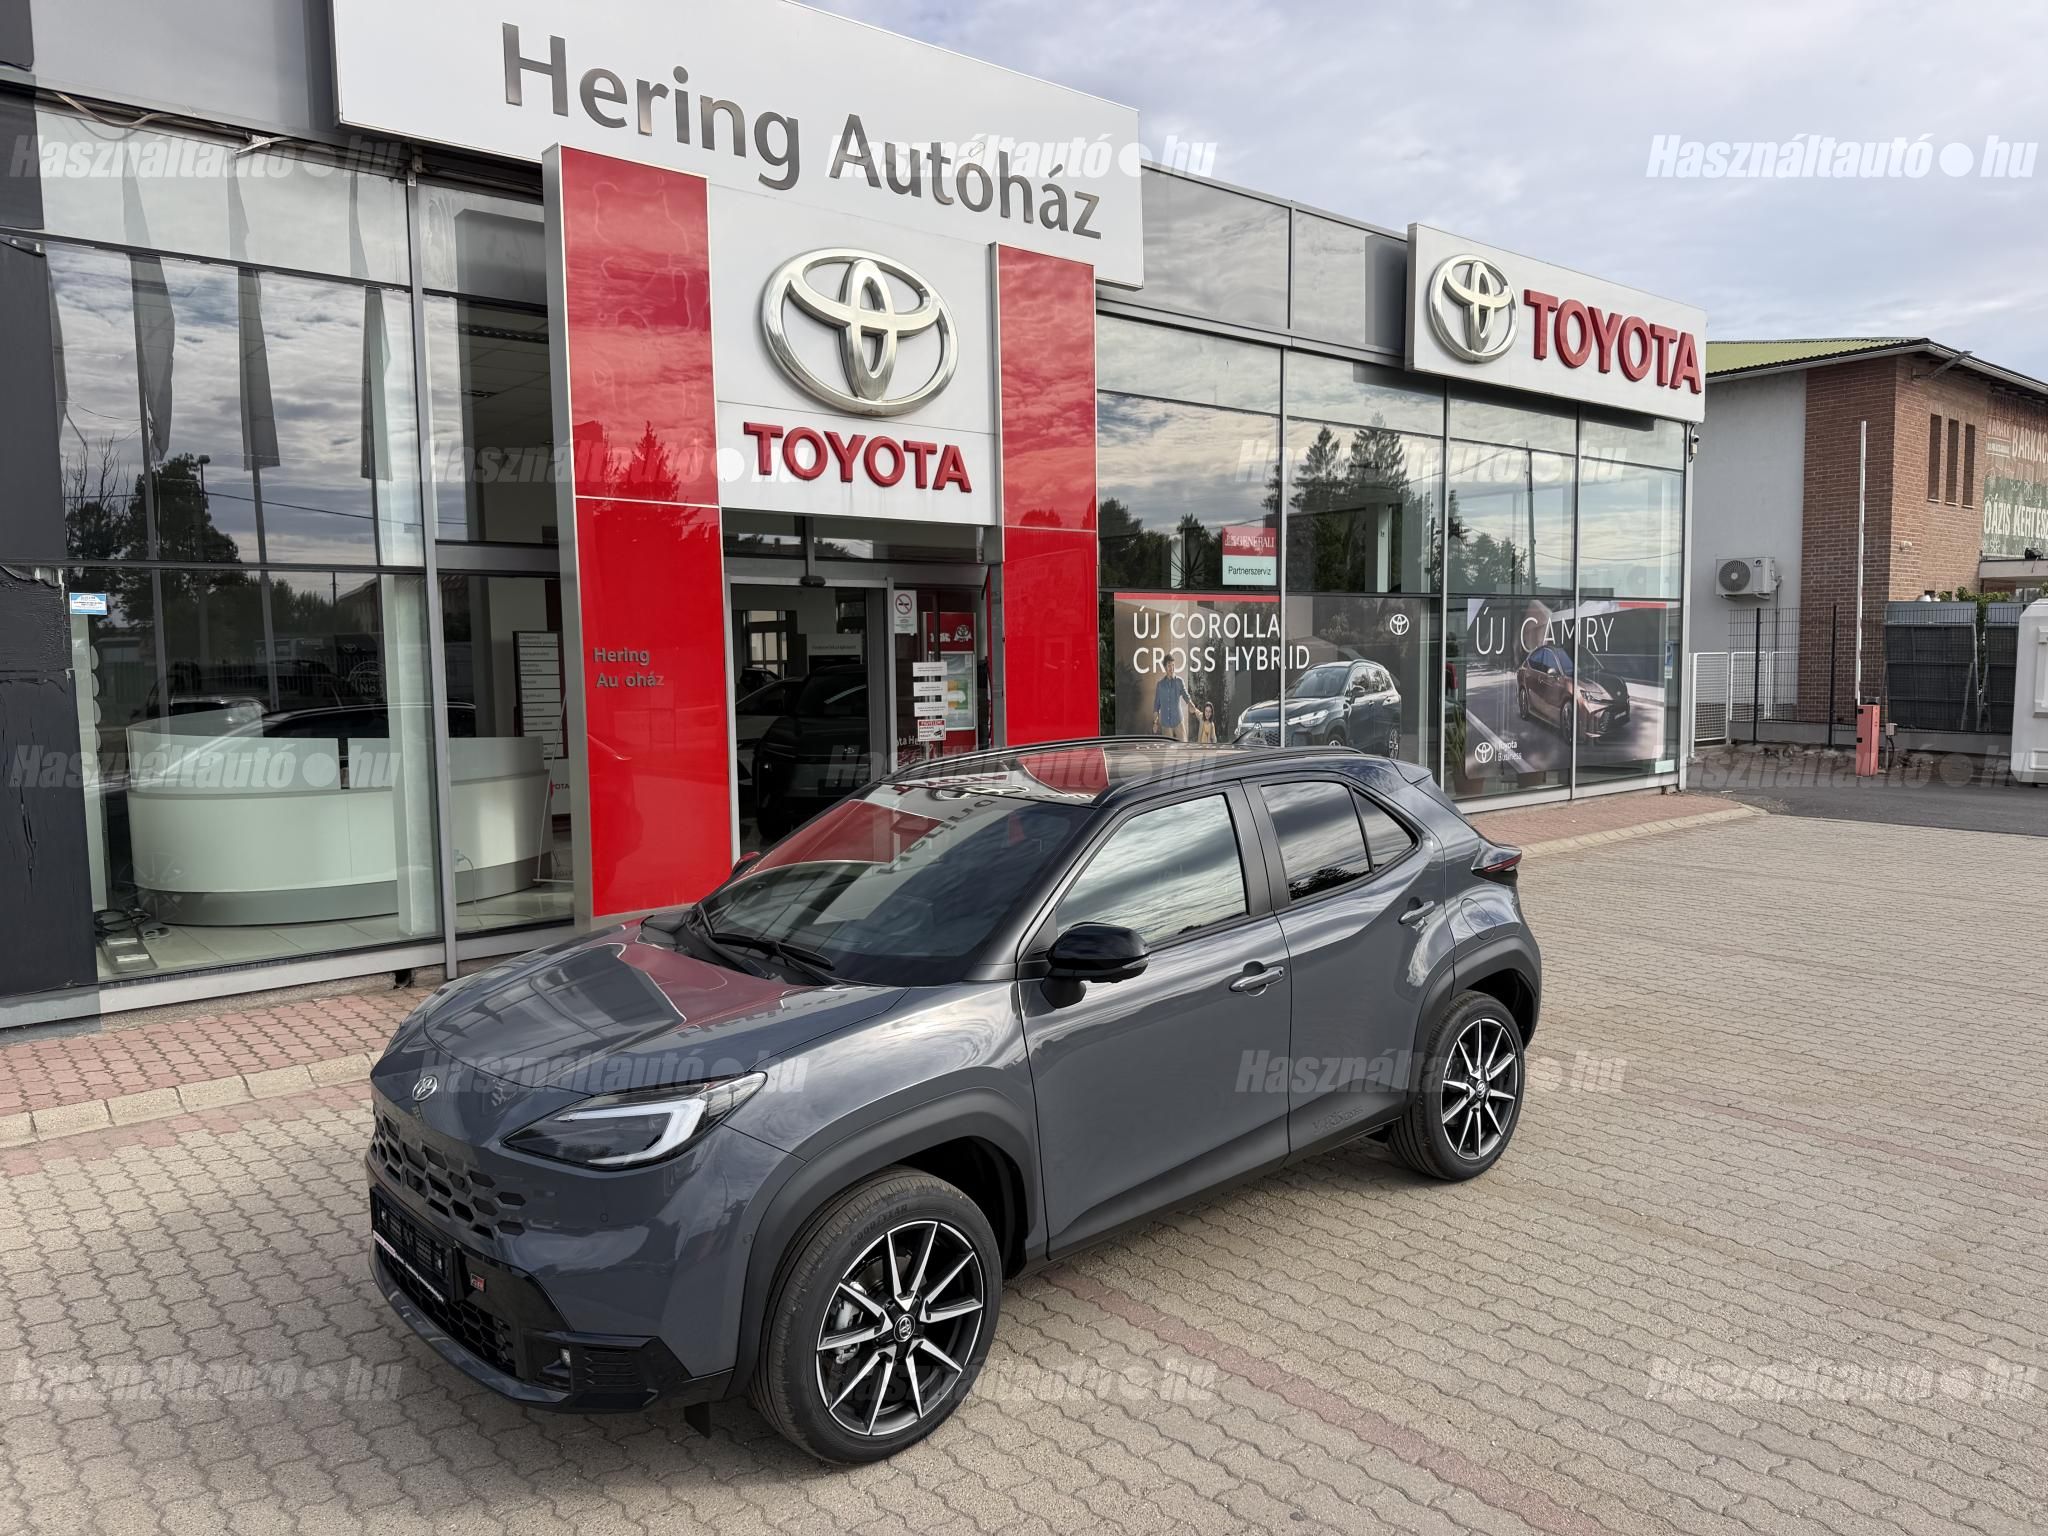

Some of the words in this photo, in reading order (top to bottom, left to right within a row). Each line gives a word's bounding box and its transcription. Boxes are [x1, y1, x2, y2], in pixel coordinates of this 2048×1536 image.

[502, 23, 799, 190] Hering
[1524, 289, 1702, 394] TOYOTA
[743, 421, 972, 493] TOYOTA
[1984, 493, 2011, 535] OÁZIS
[2013, 500, 2048, 539] KERTÉS
[1133, 606, 1160, 639] ÚJ
[1170, 612, 1280, 639] COROLLA
[1476, 606, 1506, 655] ÚJ
[1520, 616, 1614, 653] CAMRY
[594, 646, 650, 666] Hering
[1133, 646, 1216, 674] CROSS
[1225, 645, 1310, 672] HYBRID
